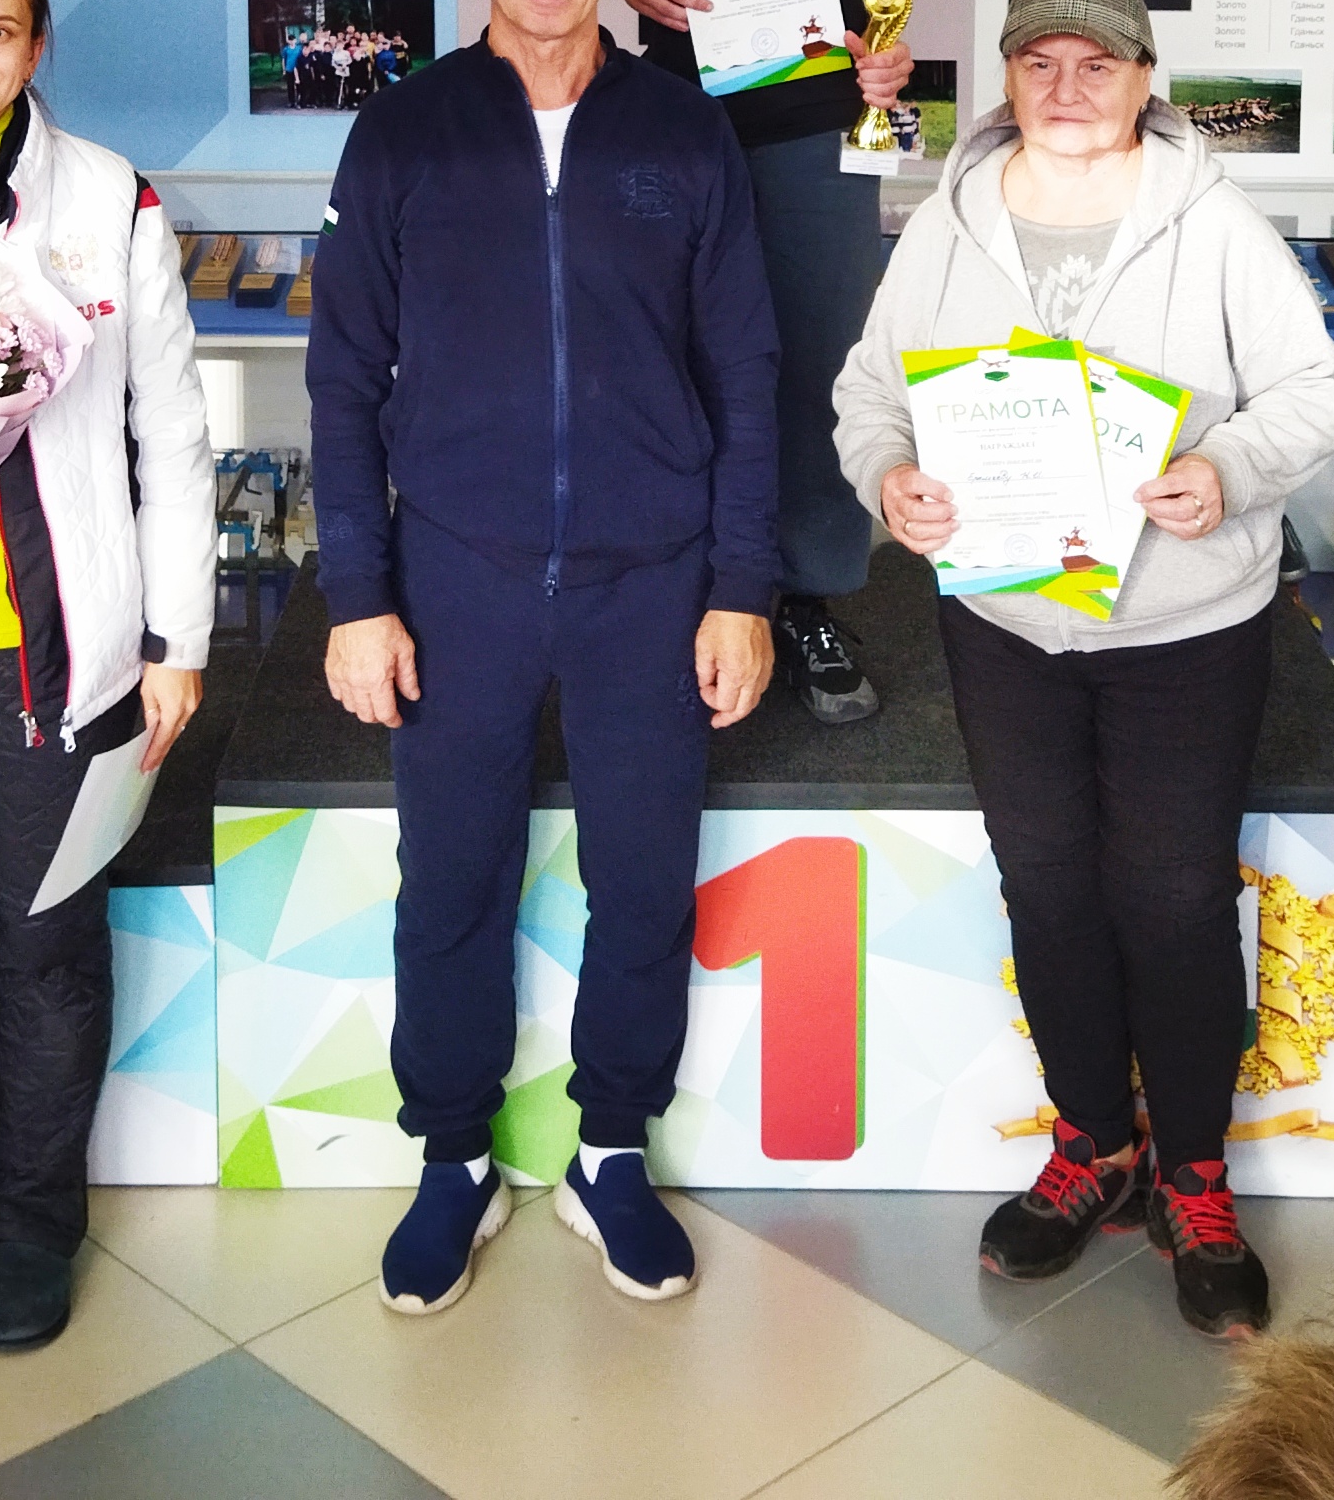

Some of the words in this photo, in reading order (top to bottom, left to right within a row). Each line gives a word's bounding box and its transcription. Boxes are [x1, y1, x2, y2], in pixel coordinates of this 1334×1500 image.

[77, 300, 115, 321] US
[936, 398, 1070, 423] ГРАМОТА
[693, 836, 867, 1161] 1
